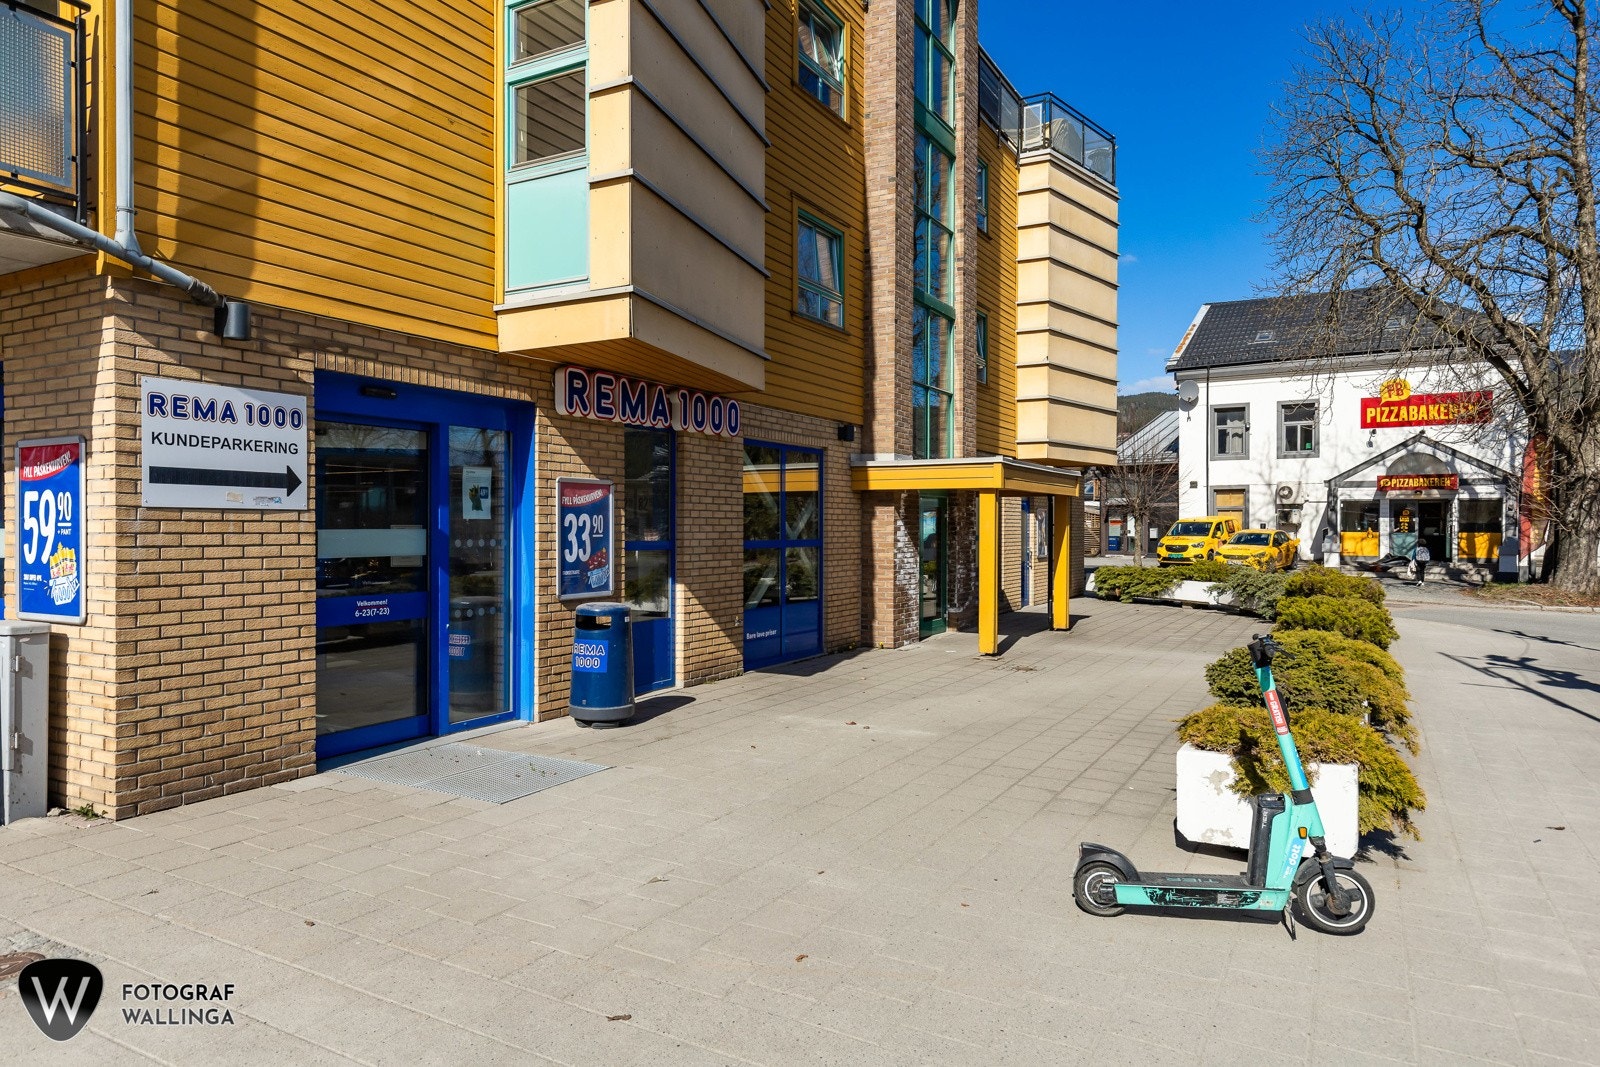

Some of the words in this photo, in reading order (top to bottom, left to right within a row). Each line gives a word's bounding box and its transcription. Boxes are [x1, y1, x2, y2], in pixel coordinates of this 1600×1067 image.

[147, 391, 238, 424] REMA
[244, 402, 303, 430] 1000
[563, 366, 671, 428] REMA
[677, 389, 741, 437] 1000
[151, 431, 299, 455] KUNDEPARKERING
[1391, 477, 1451, 488] PIZZABAKEREN
[23, 489, 56, 565] 59
[57, 491, 72, 522] 90
[563, 513, 591, 563] 33
[592, 514, 604, 534] 90
[573, 642, 606, 656] REMA
[575, 656, 601, 668] 1000
[1288, 844, 1302, 866] dott
